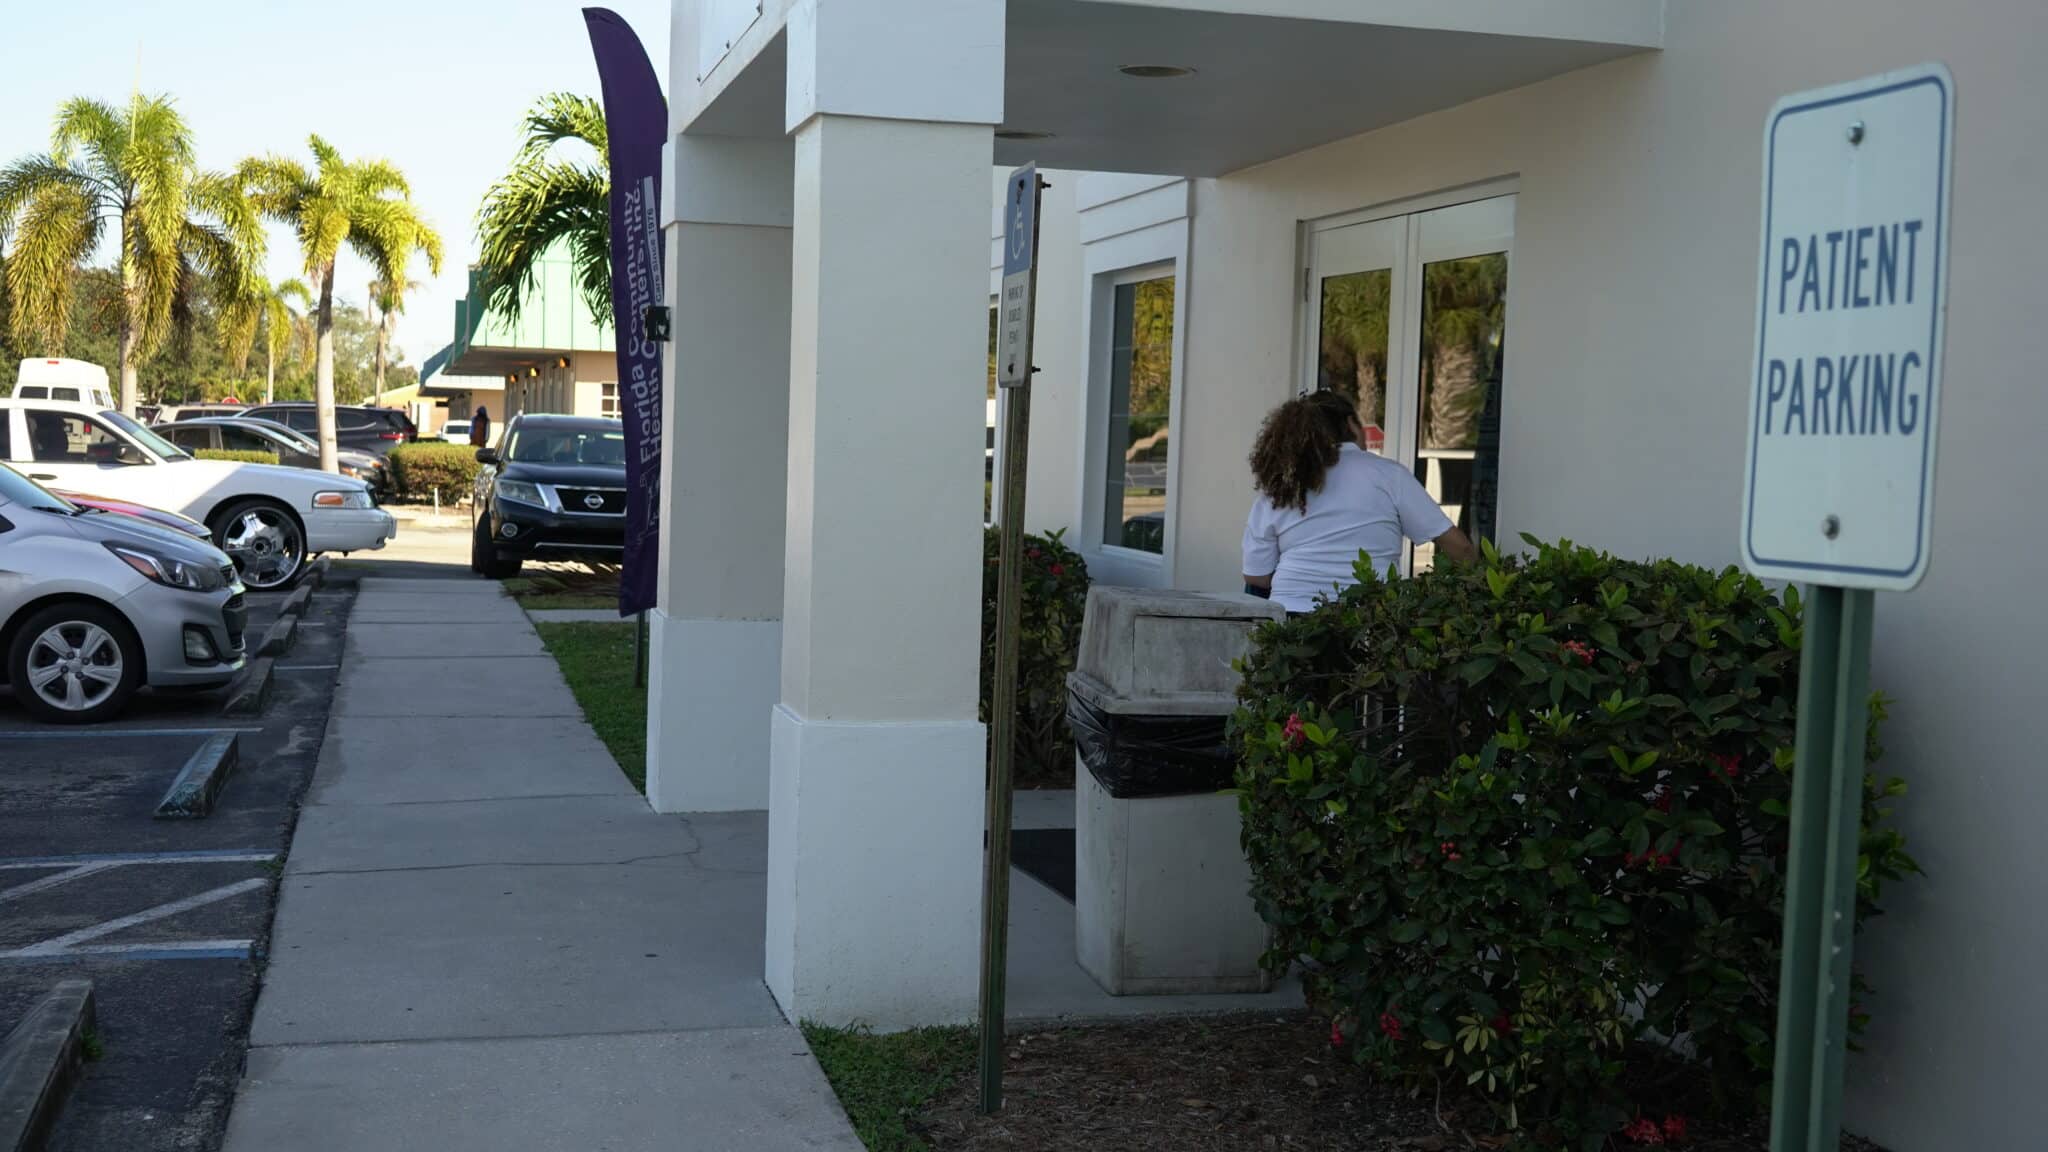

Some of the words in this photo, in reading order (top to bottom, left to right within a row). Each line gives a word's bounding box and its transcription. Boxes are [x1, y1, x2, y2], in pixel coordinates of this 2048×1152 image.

[633, 179, 642, 232] Inc.
[647, 208, 655, 234] 1976
[624, 191, 640, 357] Community
[637, 239, 657, 359] Cnters,
[1778, 219, 1923, 315] PATIENT
[631, 363, 652, 464] Florida
[648, 367, 662, 458] Health
[1764, 351, 1922, 436] PARKING
